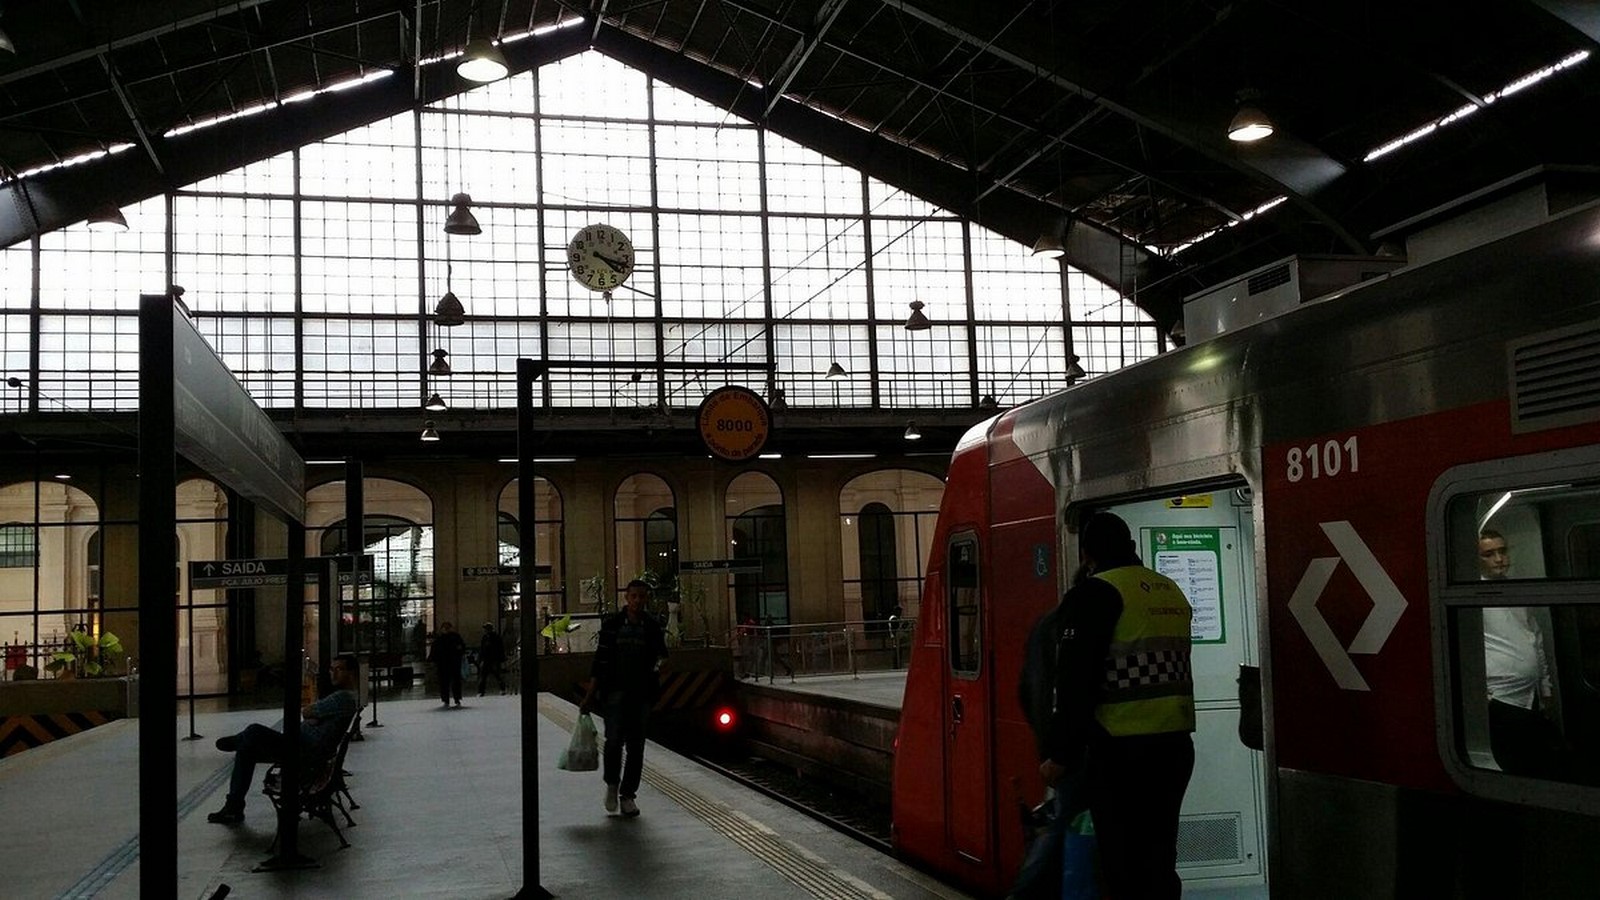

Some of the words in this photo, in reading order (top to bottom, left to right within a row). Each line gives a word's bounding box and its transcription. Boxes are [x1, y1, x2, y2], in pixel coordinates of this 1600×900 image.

[585, 231, 592, 241] 11
[597, 230, 605, 239] 12
[610, 233, 614, 243] 1
[618, 242, 625, 251] 2
[573, 253, 580, 262] 9
[577, 265, 584, 275] 8
[587, 274, 593, 283] 7
[598, 278, 605, 286] 6
[610, 274, 616, 283] 5
[717, 419, 752, 431] 8000
[1286, 435, 1359, 483] 8101
[222, 560, 267, 576] SAÍDA
